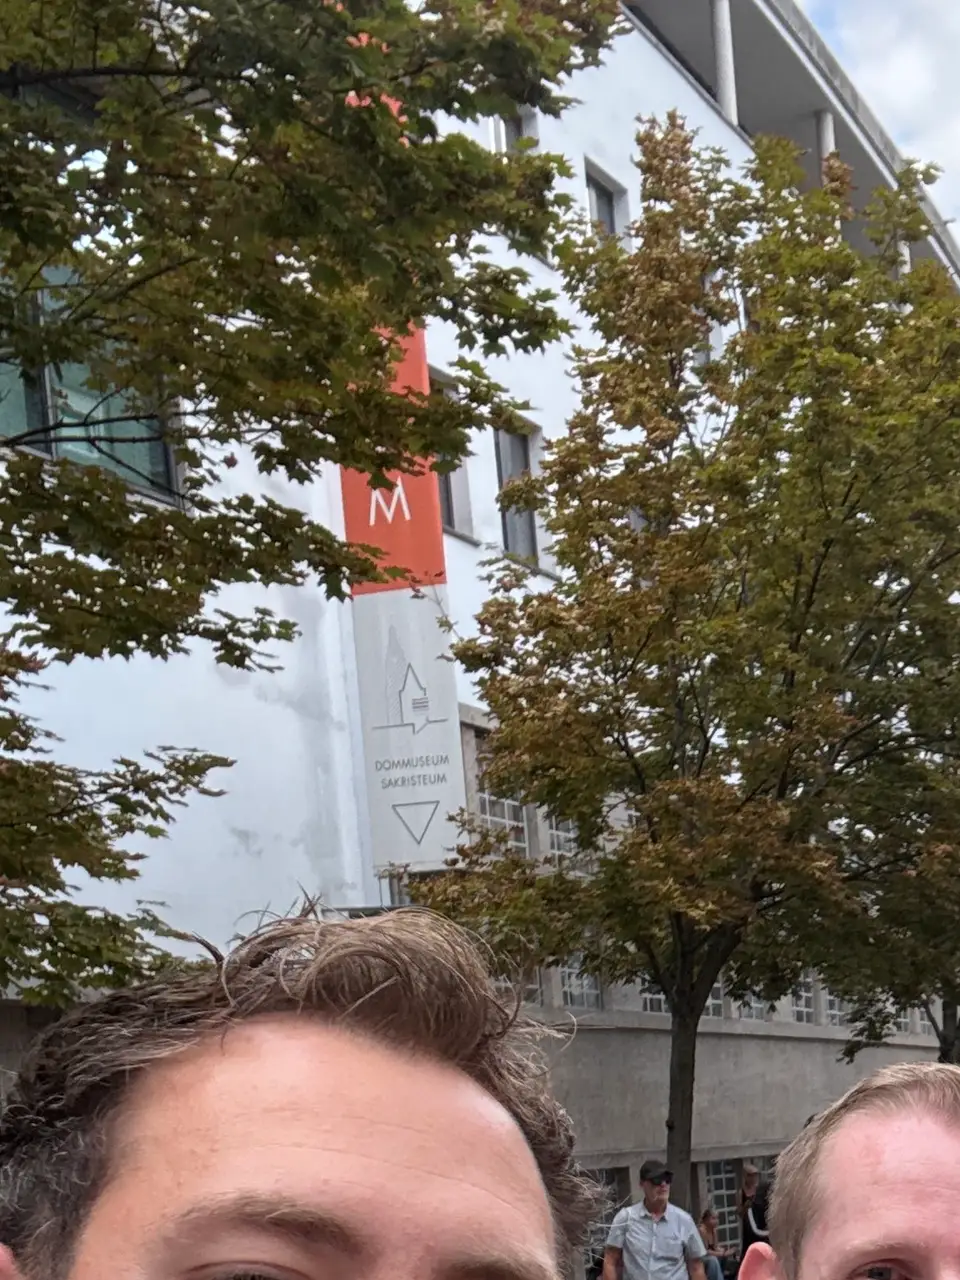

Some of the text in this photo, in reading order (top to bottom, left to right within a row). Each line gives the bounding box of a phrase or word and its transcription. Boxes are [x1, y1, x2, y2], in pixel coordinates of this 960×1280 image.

[369, 475, 411, 527] M
[374, 754, 450, 771] DOMMUSEUM
[381, 773, 447, 789] SAKRISTEUM
